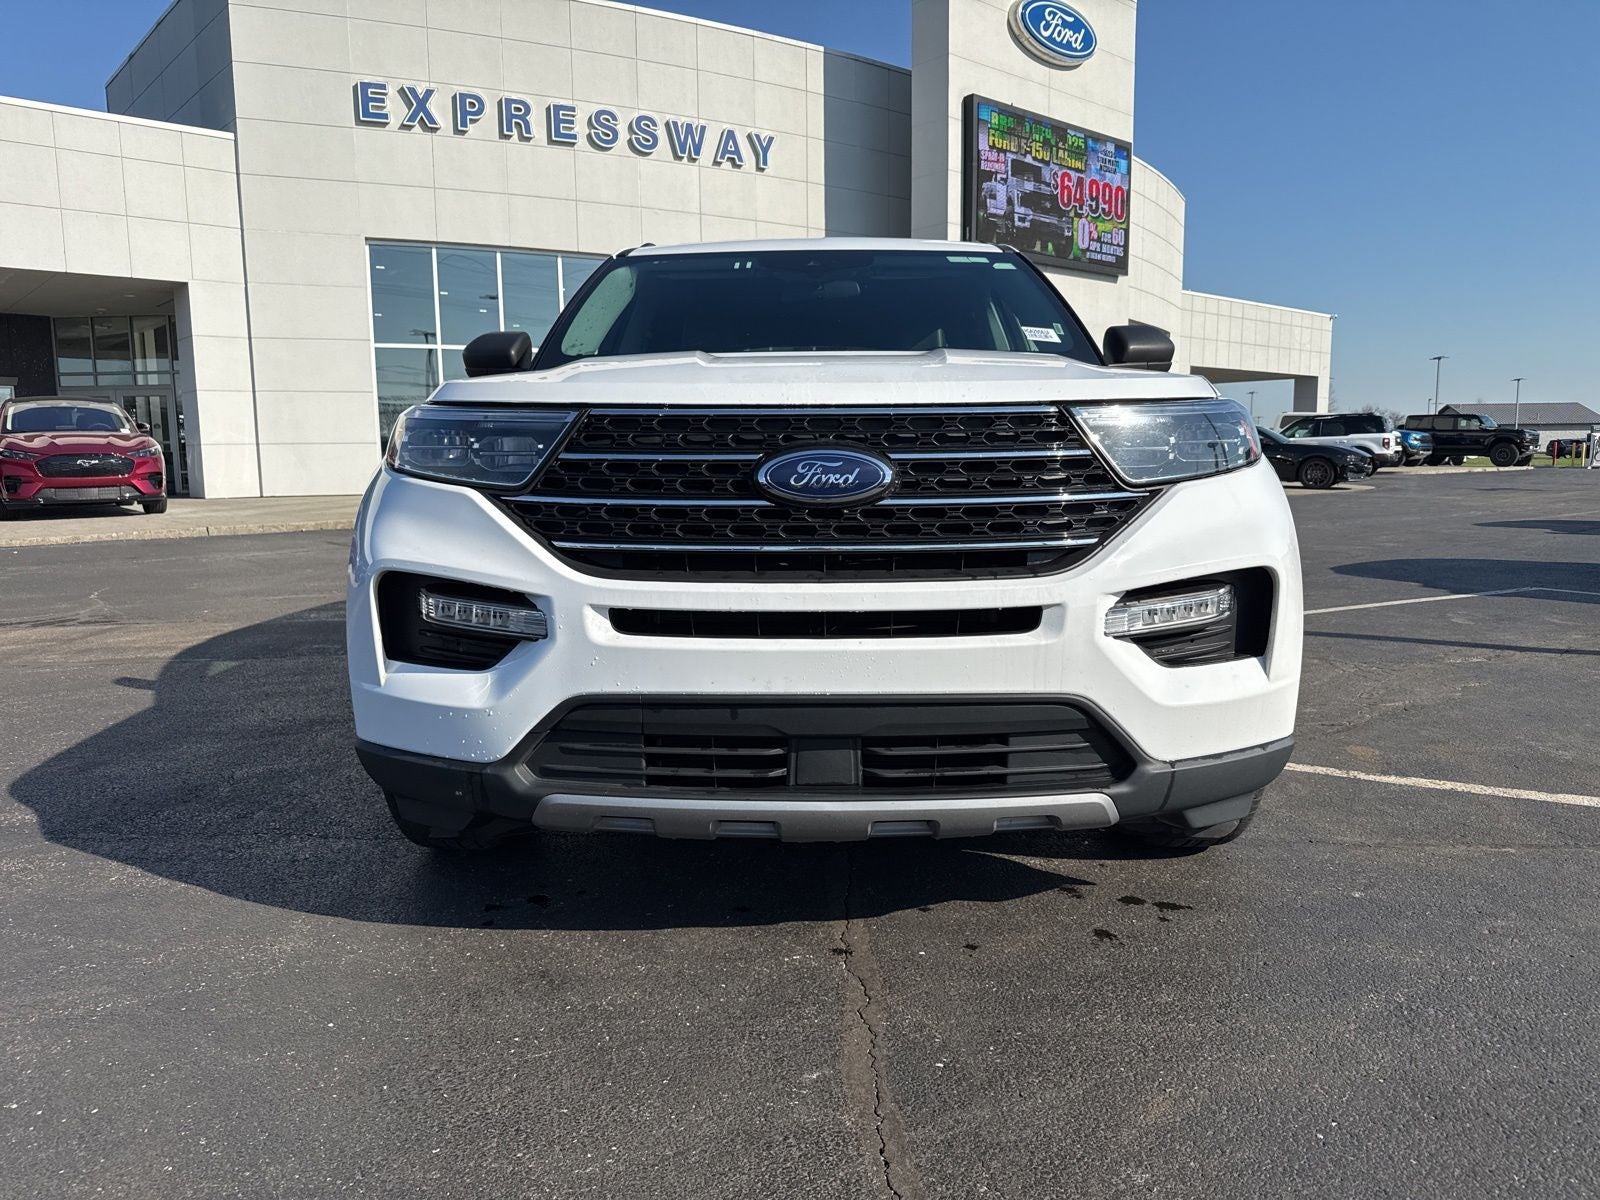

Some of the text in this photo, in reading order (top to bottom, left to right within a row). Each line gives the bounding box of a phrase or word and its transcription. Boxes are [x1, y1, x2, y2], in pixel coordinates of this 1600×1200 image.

[1040, 7, 1085, 50] Ford
[355, 80, 776, 170] EXPRESSWAY
[989, 128, 1019, 153] FORD
[1112, 227, 1125, 246] 60
[789, 460, 861, 489] Ford
